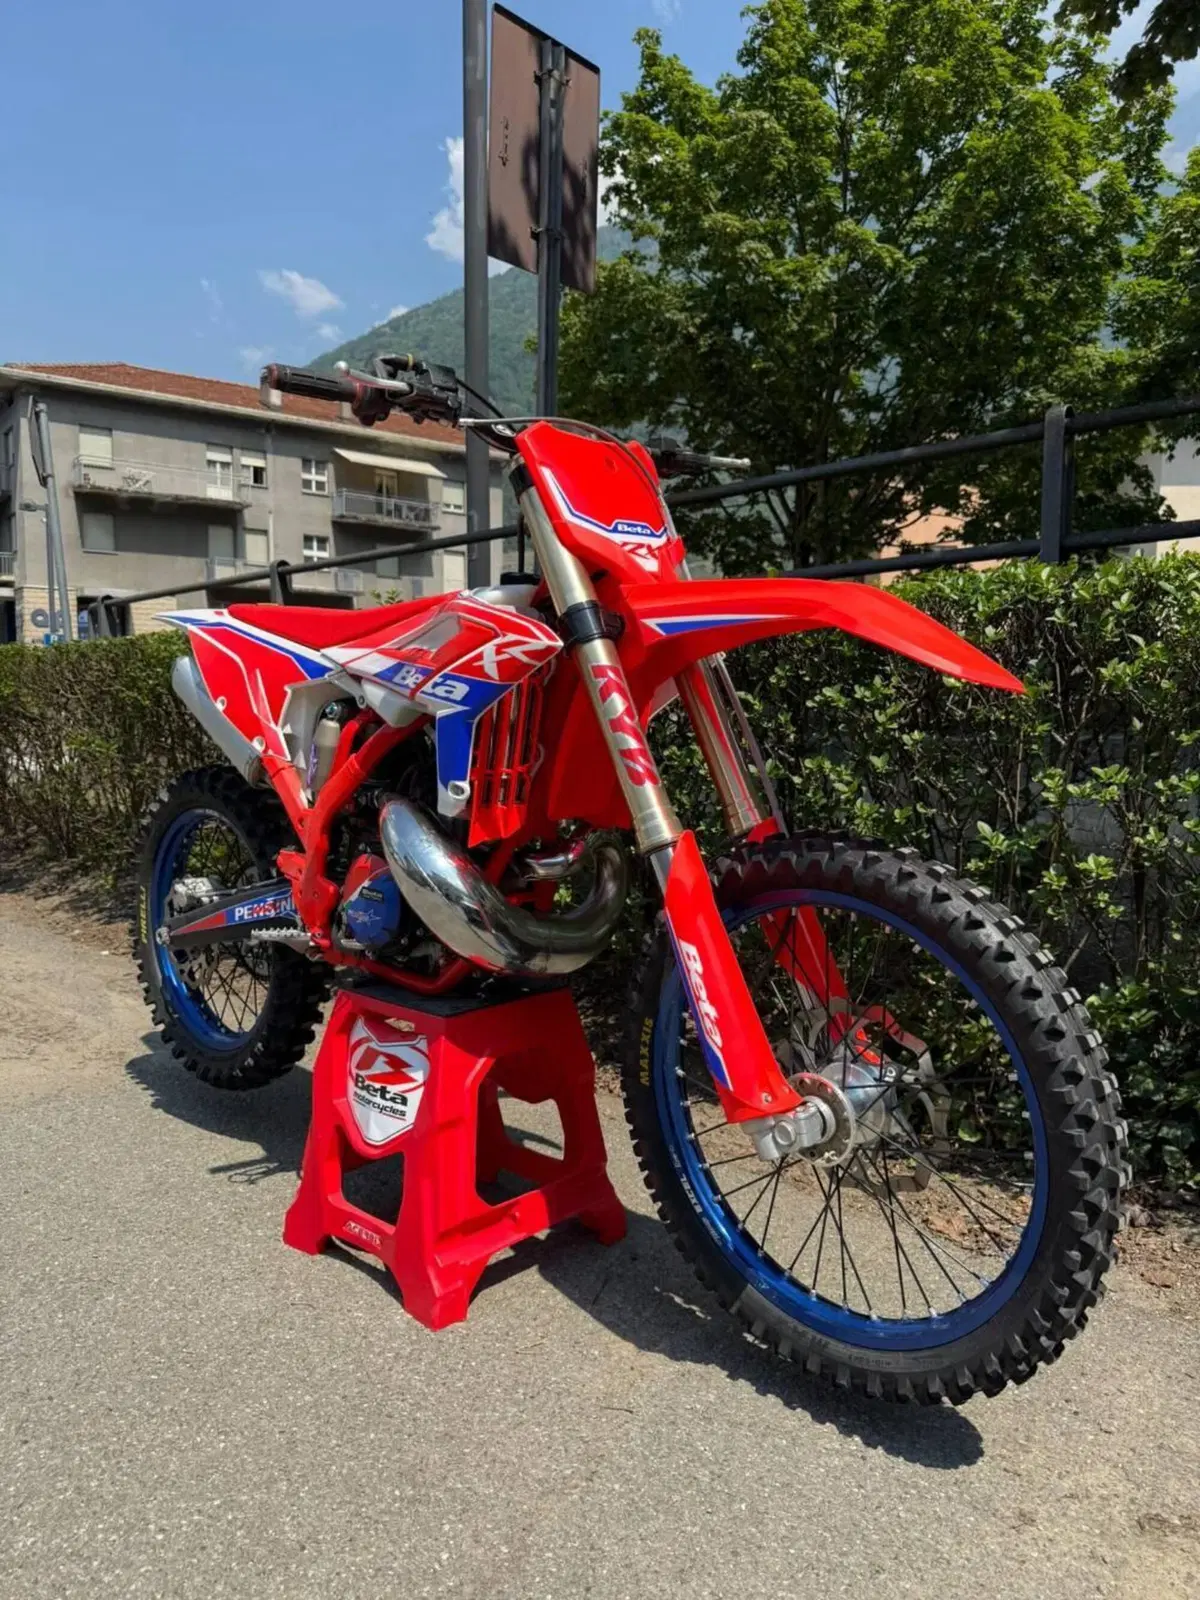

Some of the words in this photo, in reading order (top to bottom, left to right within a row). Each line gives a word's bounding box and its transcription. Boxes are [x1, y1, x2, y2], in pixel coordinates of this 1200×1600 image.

[617, 523, 651, 535] Beta
[140, 885, 148, 944] PIRELLI
[678, 938, 723, 1048] Beta
[640, 1018, 653, 1086] MAXXIS
[354, 1072, 409, 1107] Beta
